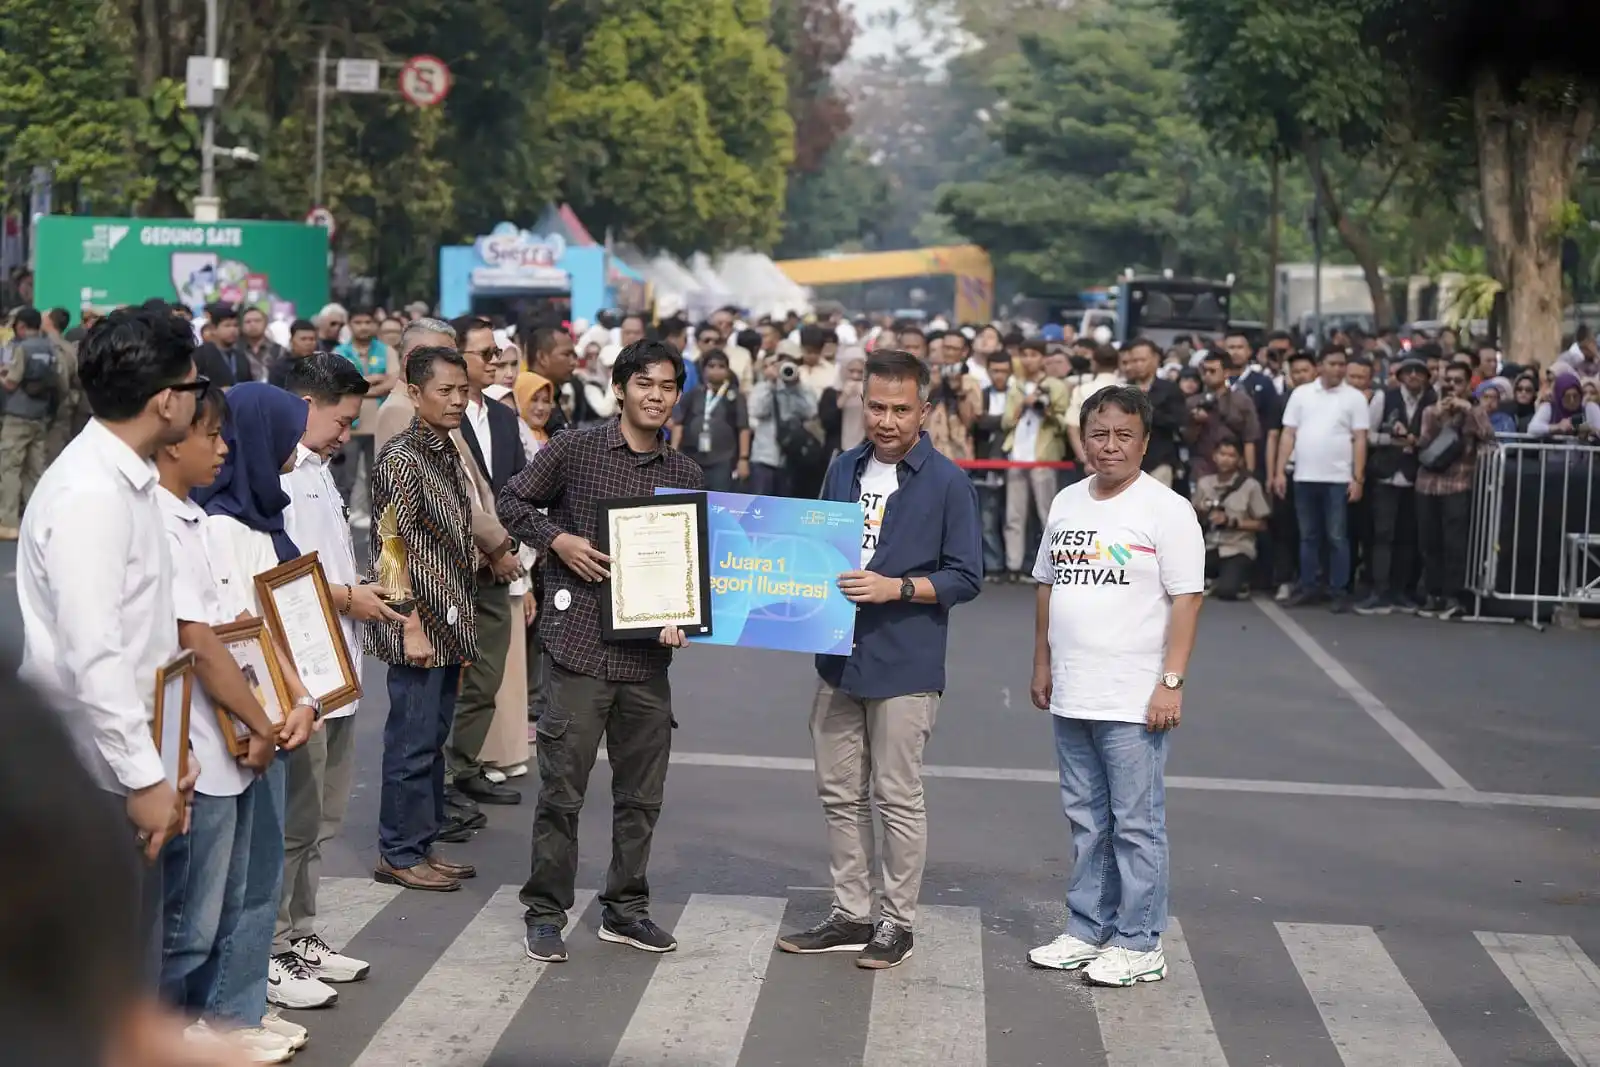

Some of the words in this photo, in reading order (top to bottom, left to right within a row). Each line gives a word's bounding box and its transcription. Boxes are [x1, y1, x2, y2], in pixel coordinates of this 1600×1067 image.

[140, 226, 204, 246] GEDUNG
[206, 226, 242, 246] SATE
[1050, 530, 1097, 546] WEST
[719, 551, 773, 573] Juara
[777, 557, 786, 573] 1
[709, 573, 753, 595] egori
[757, 575, 829, 600] Ilustrasi
[1054, 568, 1130, 586] ESTIVAL
